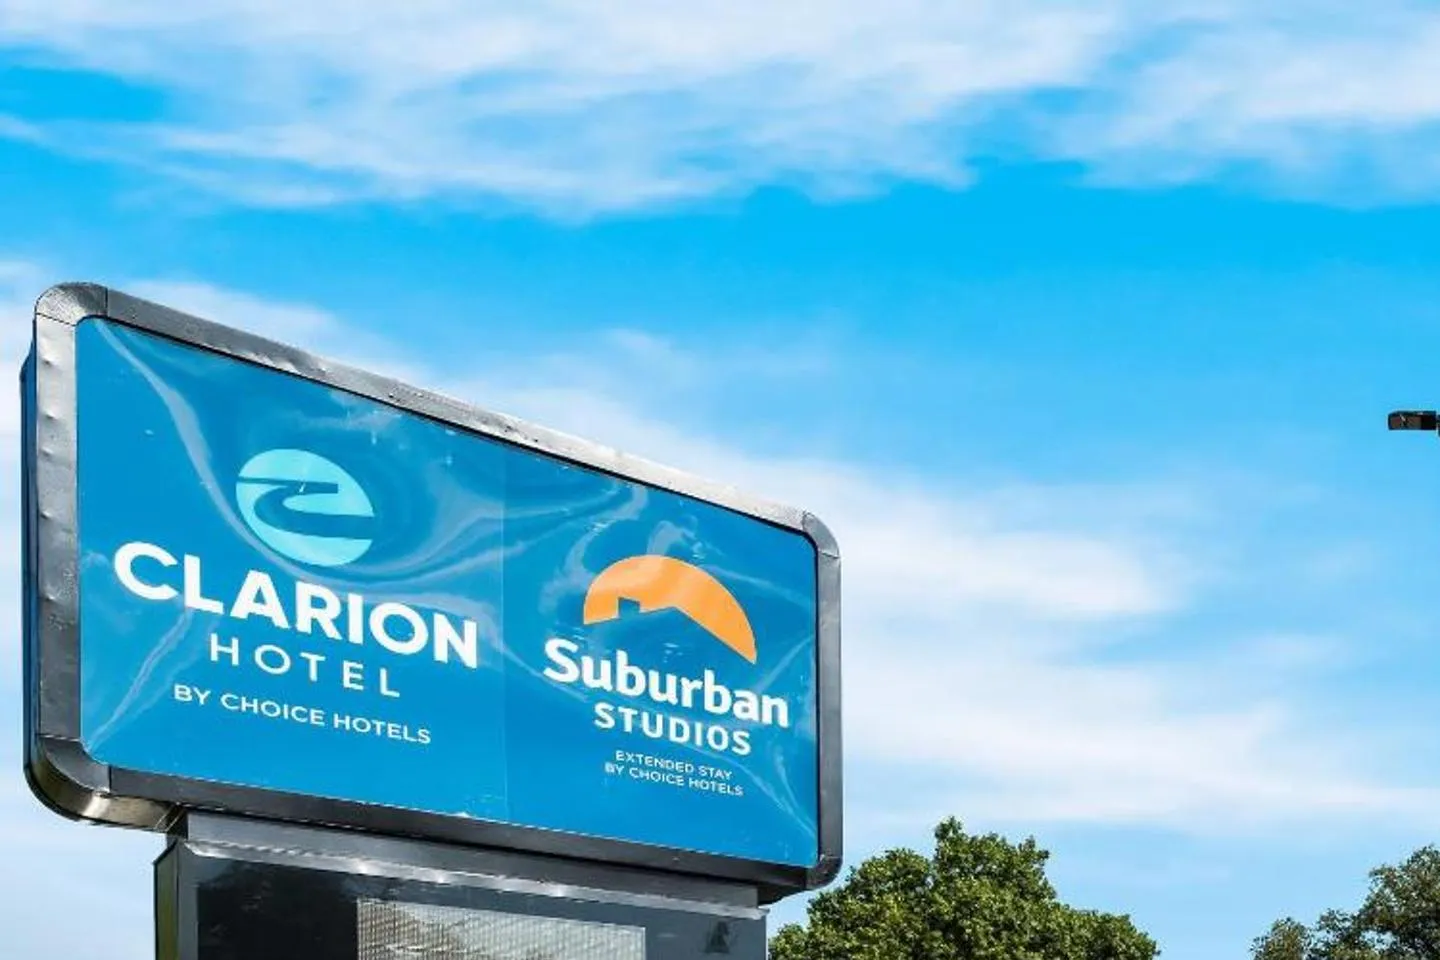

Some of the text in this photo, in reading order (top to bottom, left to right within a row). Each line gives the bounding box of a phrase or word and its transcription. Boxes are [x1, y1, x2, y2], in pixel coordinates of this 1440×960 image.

[113, 541, 478, 669] CLARION
[209, 633, 401, 698] HOTEL
[543, 638, 790, 729] Suburban
[173, 684, 432, 745] BY CHOICE HOTELS
[594, 702, 752, 756] STUDIOS
[604, 762, 744, 797] BY CHOICE HOTELS
[615, 750, 733, 781] EXTENDED STAY
